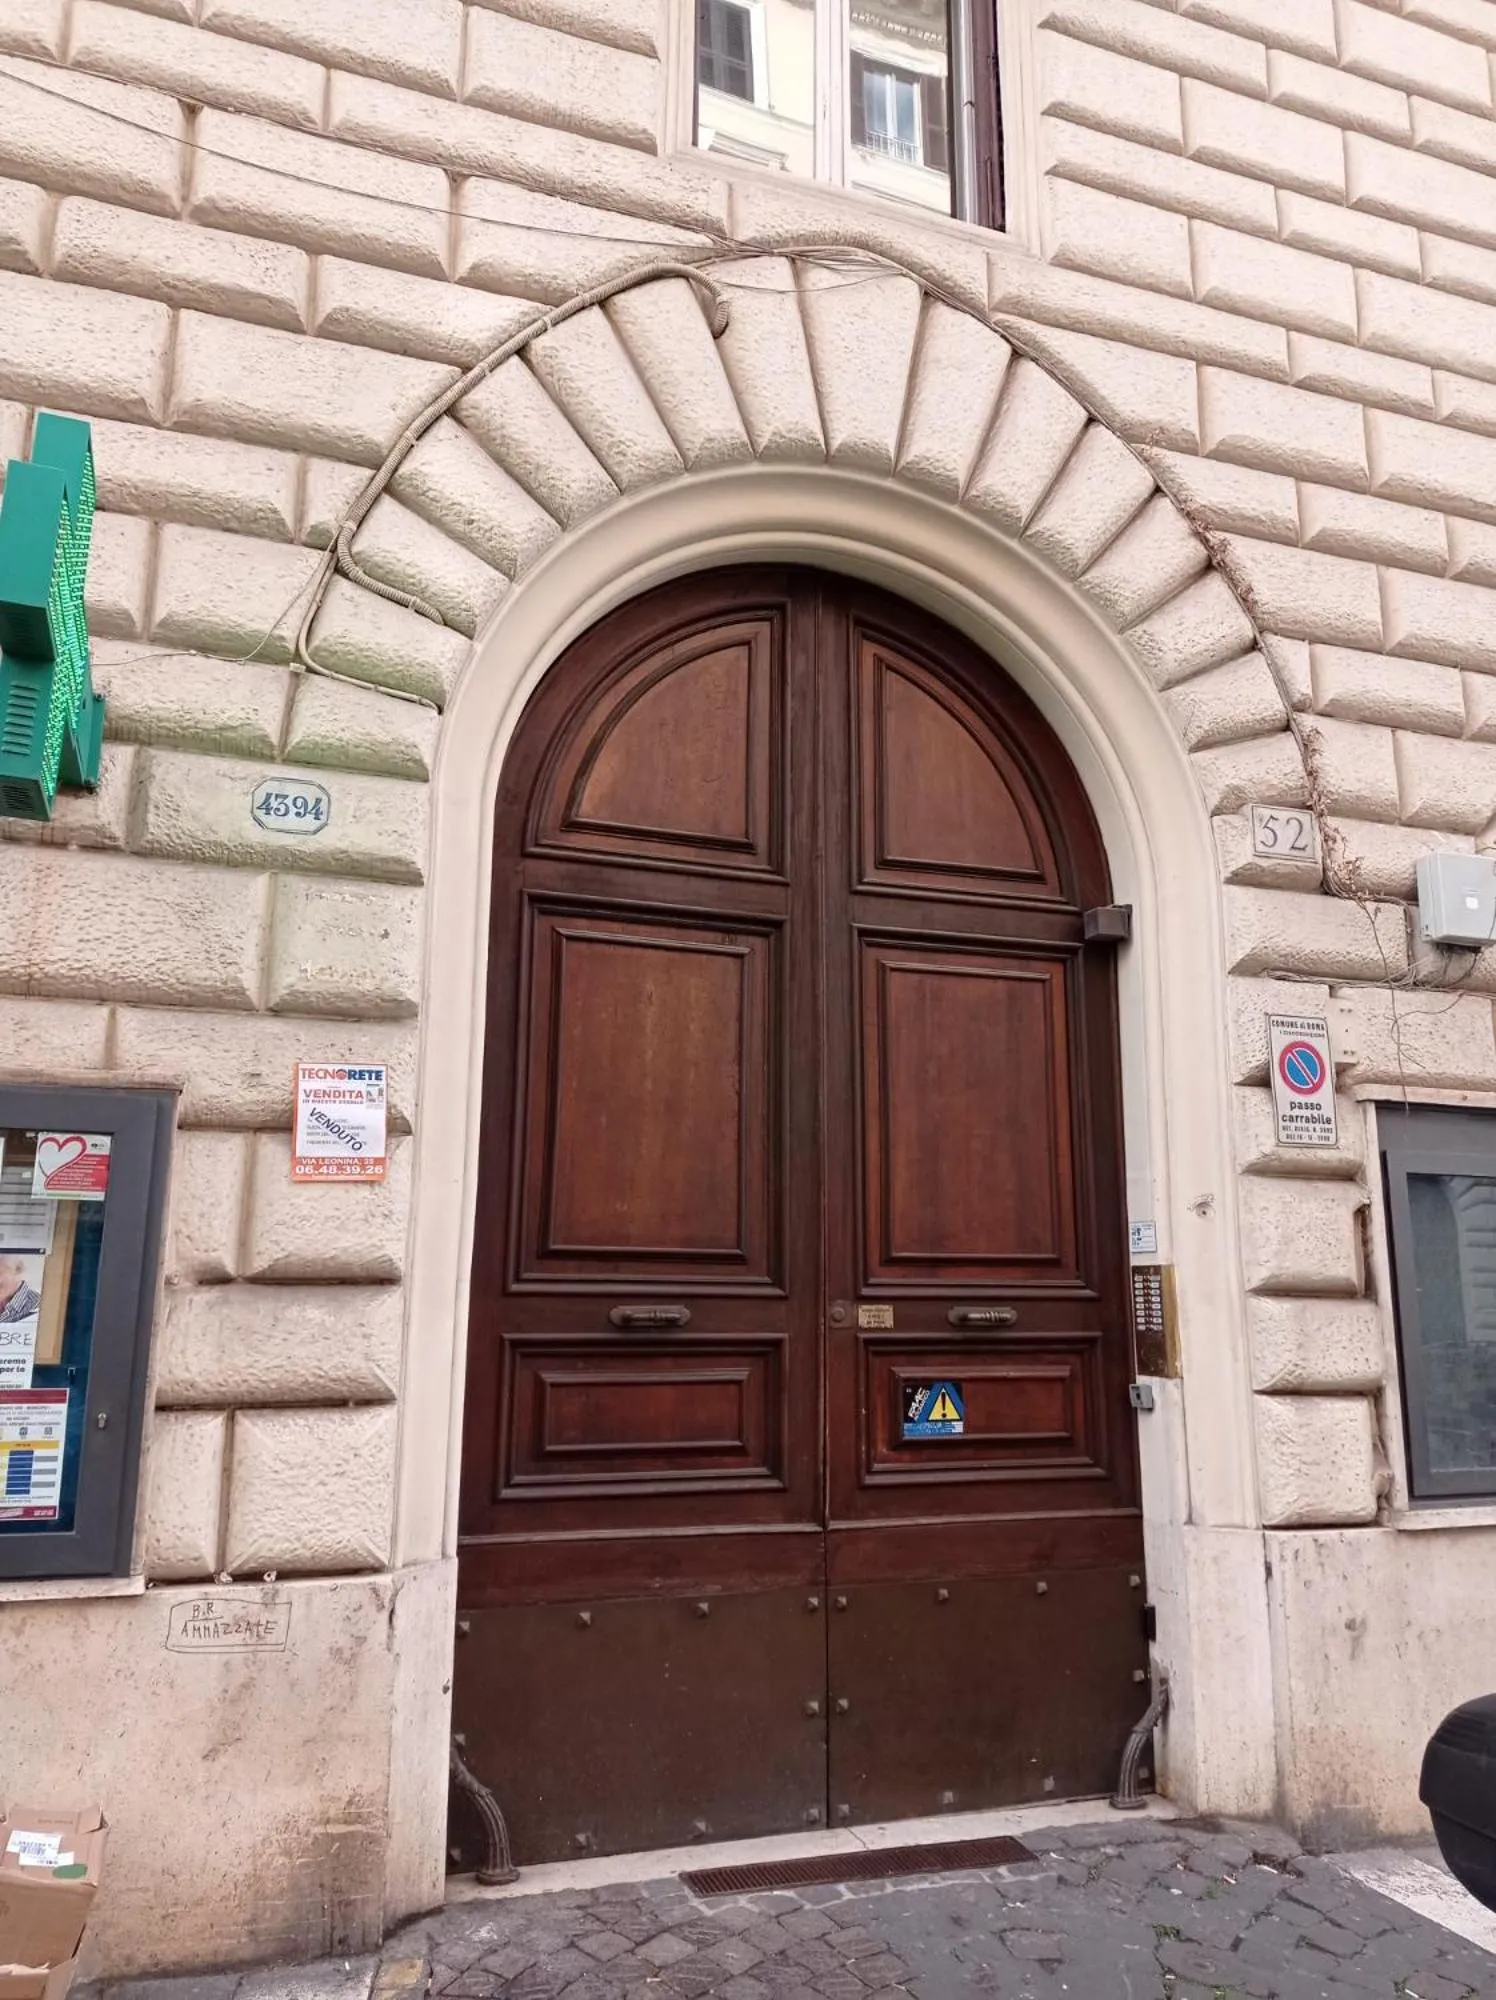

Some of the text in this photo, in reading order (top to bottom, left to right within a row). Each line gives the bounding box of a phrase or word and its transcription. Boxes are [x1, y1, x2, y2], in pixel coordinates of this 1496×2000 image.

[256, 792, 324, 821] 4394
[1260, 814, 1309, 852] 52
[1271, 1019, 1298, 1029] COMUNE
[300, 1067, 384, 1081] TECNORETE
[303, 1089, 364, 1099] VENDITA
[1289, 1101, 1323, 1111] passo
[1281, 1113, 1333, 1125] carrabile
[309, 1106, 363, 1152] VENDUTO
[302, 1157, 317, 1165] VIA
[295, 1164, 384, 1175] 06.48.39.26
[181, 1619, 278, 1640] AMMAZZATE
